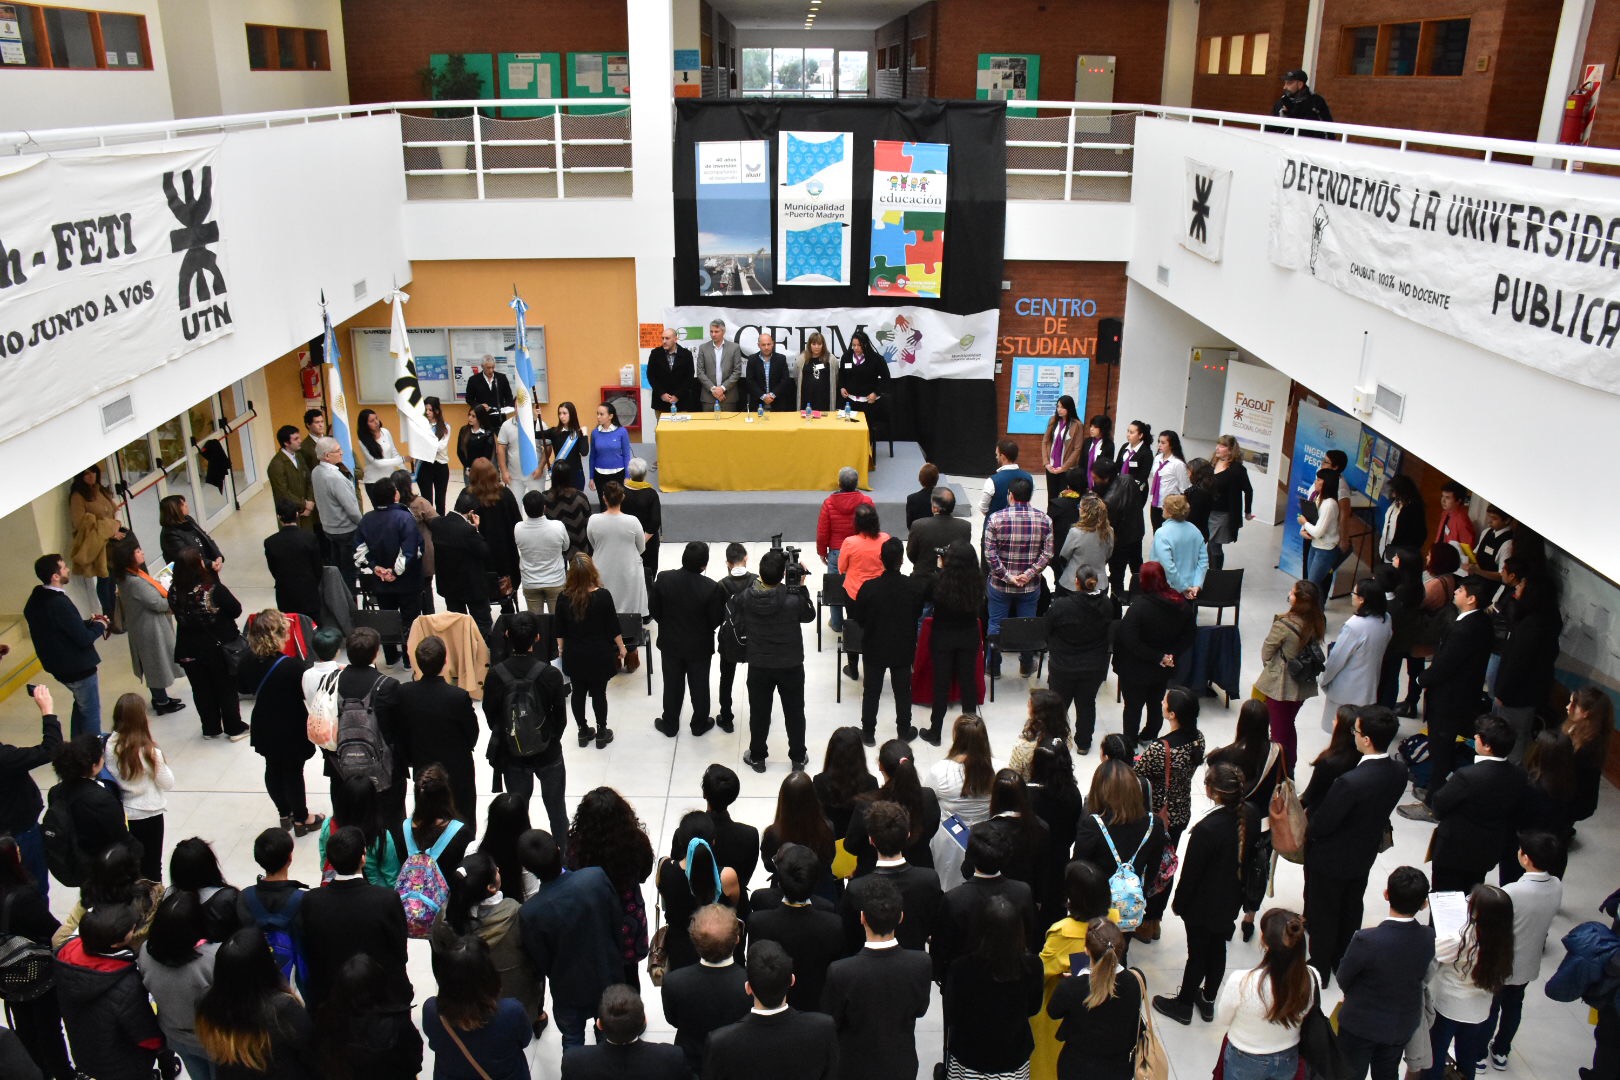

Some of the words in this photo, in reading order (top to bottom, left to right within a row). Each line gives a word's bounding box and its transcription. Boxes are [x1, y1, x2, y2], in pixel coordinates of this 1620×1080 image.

[880, 193, 942, 205] educación
[1283, 159, 1401, 223] DEFENDEMOS
[1409, 188, 1441, 231] LA
[784, 203, 845, 212] Municipalidad
[816, 212, 844, 220] Madryn
[51, 212, 137, 271] FETI
[1350, 262, 1375, 280] CHUBUT
[1378, 273, 1395, 289] 100%
[1398, 280, 1411, 297] NO
[1412, 285, 1451, 310] DOCENTE
[28, 300, 98, 347] JUNTO
[103, 295, 118, 317] A
[119, 280, 154, 309] VOS
[1015, 298, 1096, 317] CENTRO
[1491, 273, 1620, 349] PUBLICA
[181, 301, 233, 341] UTN
[1044, 317, 1068, 335] DE
[997, 336, 1098, 356] ESTUDIANT
[1304, 443, 1327, 459] INGEN
